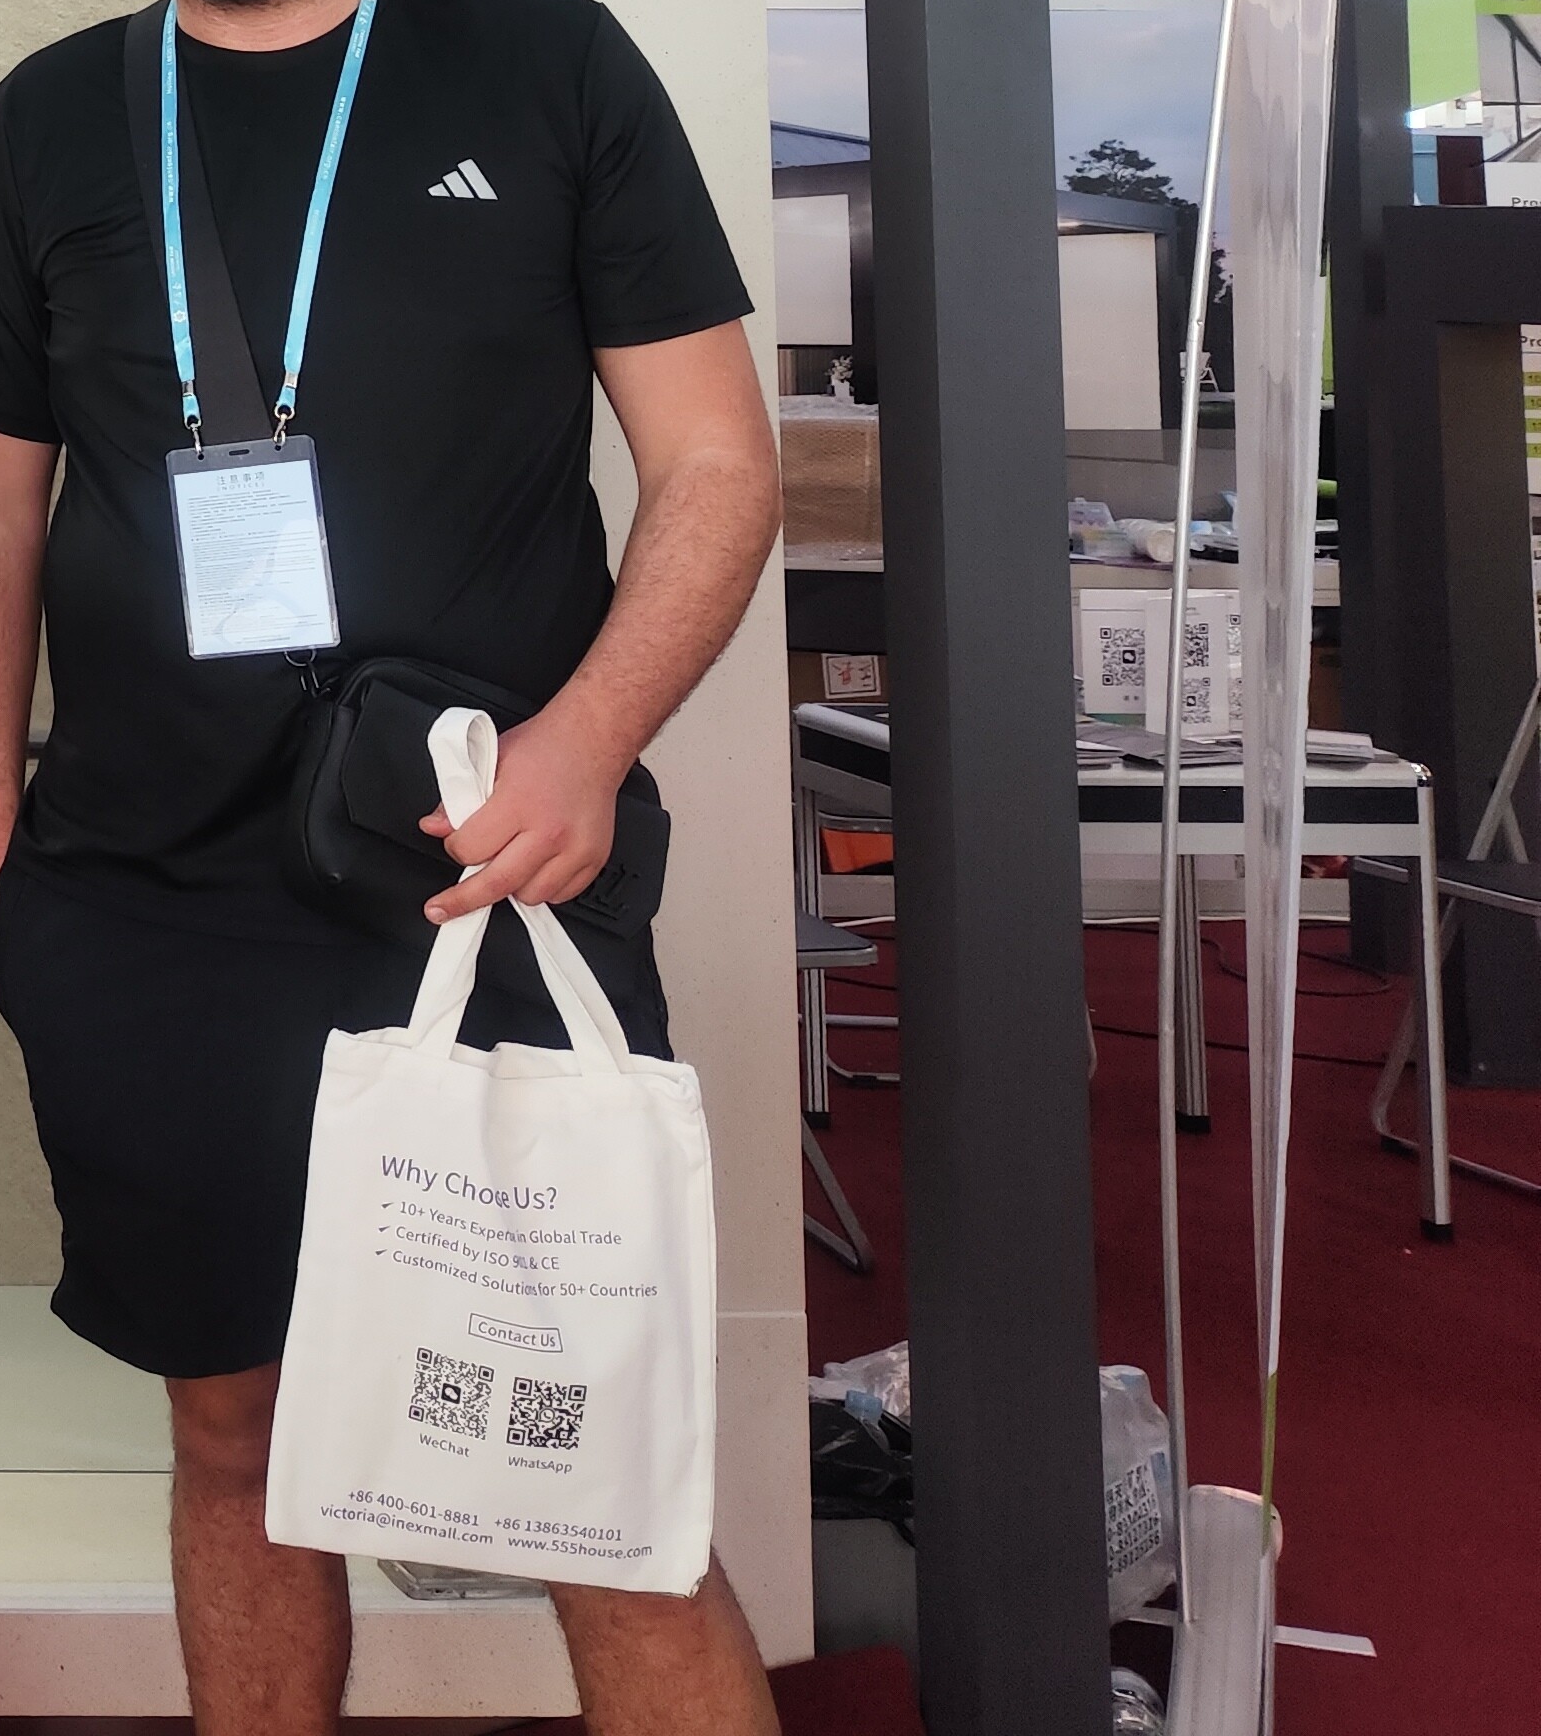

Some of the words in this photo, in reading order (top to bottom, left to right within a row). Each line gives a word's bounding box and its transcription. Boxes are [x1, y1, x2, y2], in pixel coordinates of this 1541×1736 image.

[381, 1154, 439, 1193] Why
[513, 1185, 558, 1210] Us?
[399, 1200, 426, 1217] 10+
[429, 1208, 467, 1231] Years
[529, 1229, 577, 1245] Global
[579, 1230, 622, 1245] Trade
[395, 1225, 460, 1254] Certified
[461, 1243, 481, 1263] by
[483, 1249, 510, 1267] ISO
[529, 1256, 539, 1270] &
[541, 1256, 560, 1270] CE
[392, 1250, 478, 1285] Customized
[537, 1281, 557, 1297] for
[559, 1282, 586, 1297] 50+
[588, 1282, 658, 1298] Countries
[478, 1321, 537, 1346] Contact
[540, 1333, 556, 1347] Us
[419, 1432, 471, 1458] WeChat
[507, 1455, 573, 1474] WhatsApp
[320, 1504, 494, 1545] victoria@inexmall.com
[507, 1535, 653, 1560] www.555house.com
[347, 1489, 374, 1505] +86
[376, 1492, 480, 1527] 400-601-8881
[494, 1516, 521, 1531] +86
[524, 1520, 623, 1542] 13863540101
